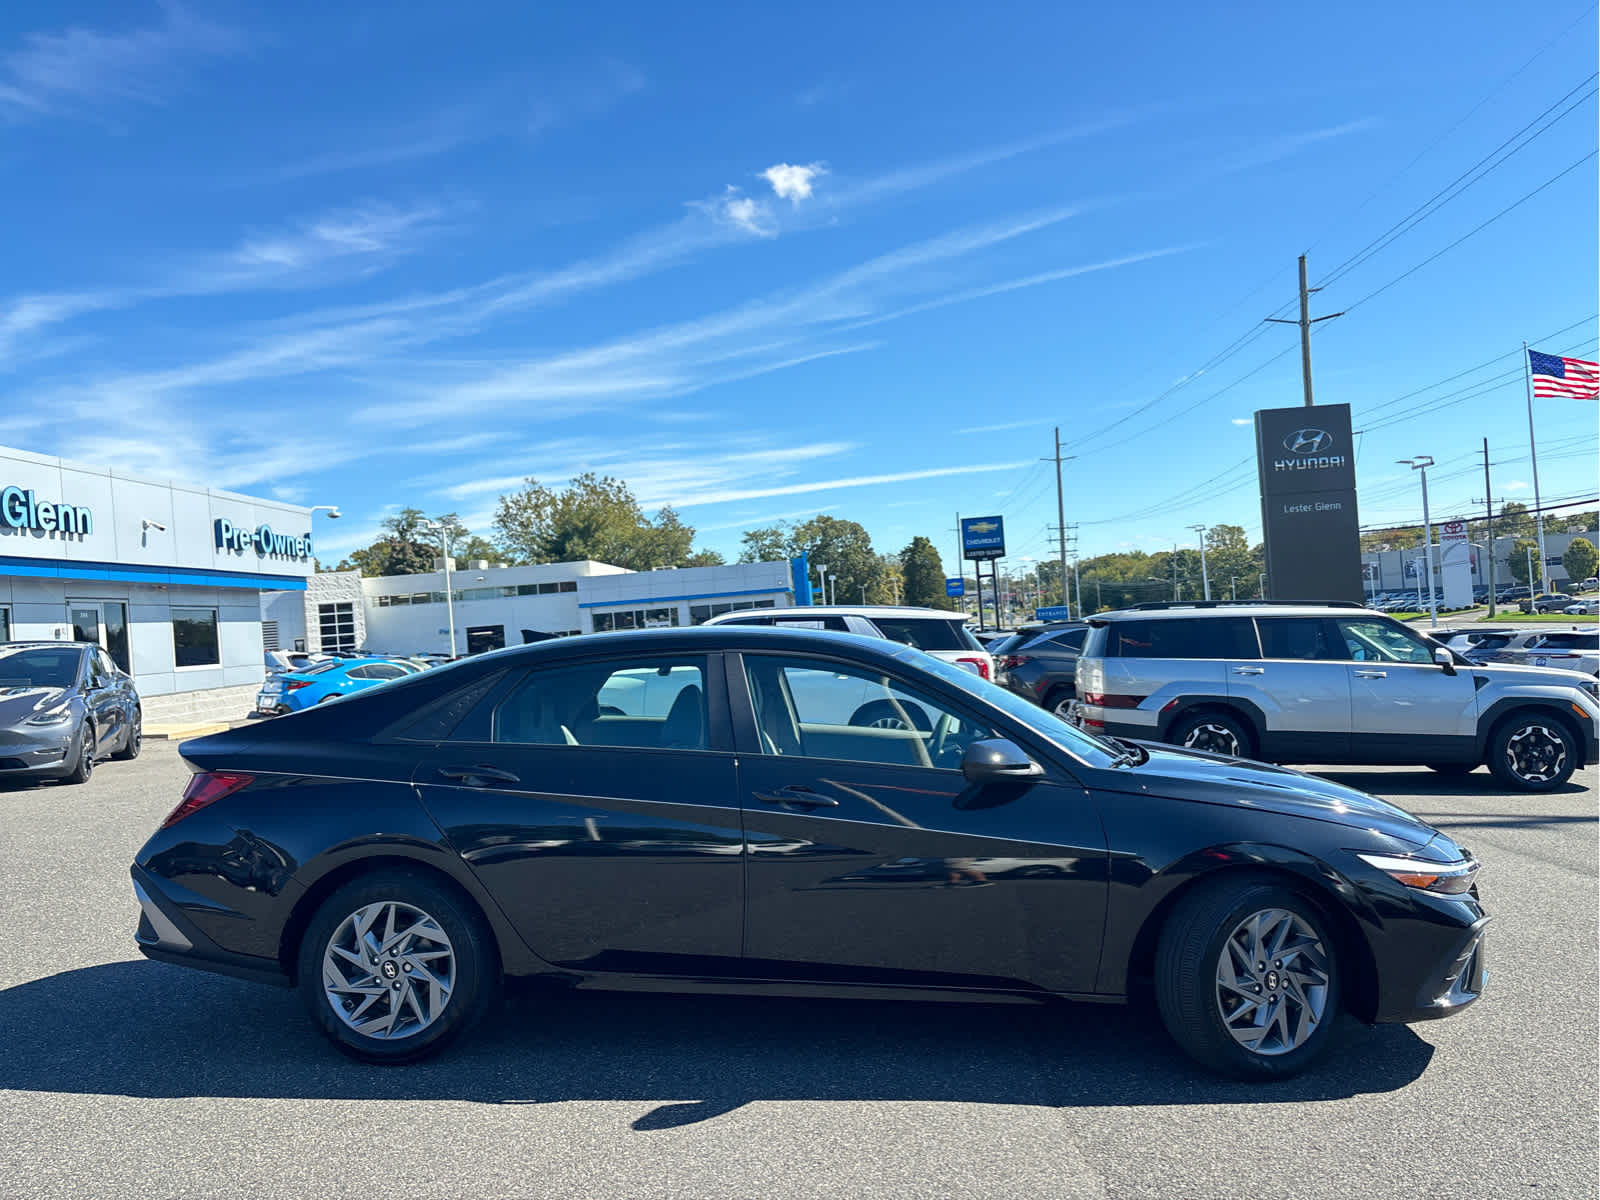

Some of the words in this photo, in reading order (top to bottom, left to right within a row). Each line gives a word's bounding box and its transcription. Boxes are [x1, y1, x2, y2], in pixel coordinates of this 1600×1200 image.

[1274, 456, 1345, 472] HYUNDAI
[1, 485, 93, 536] Glenn
[1284, 504, 1312, 514] Lester
[1315, 502, 1342, 512] Glenn
[215, 518, 314, 558] Pre-Owned
[966, 537, 1001, 546] CHEVROLET
